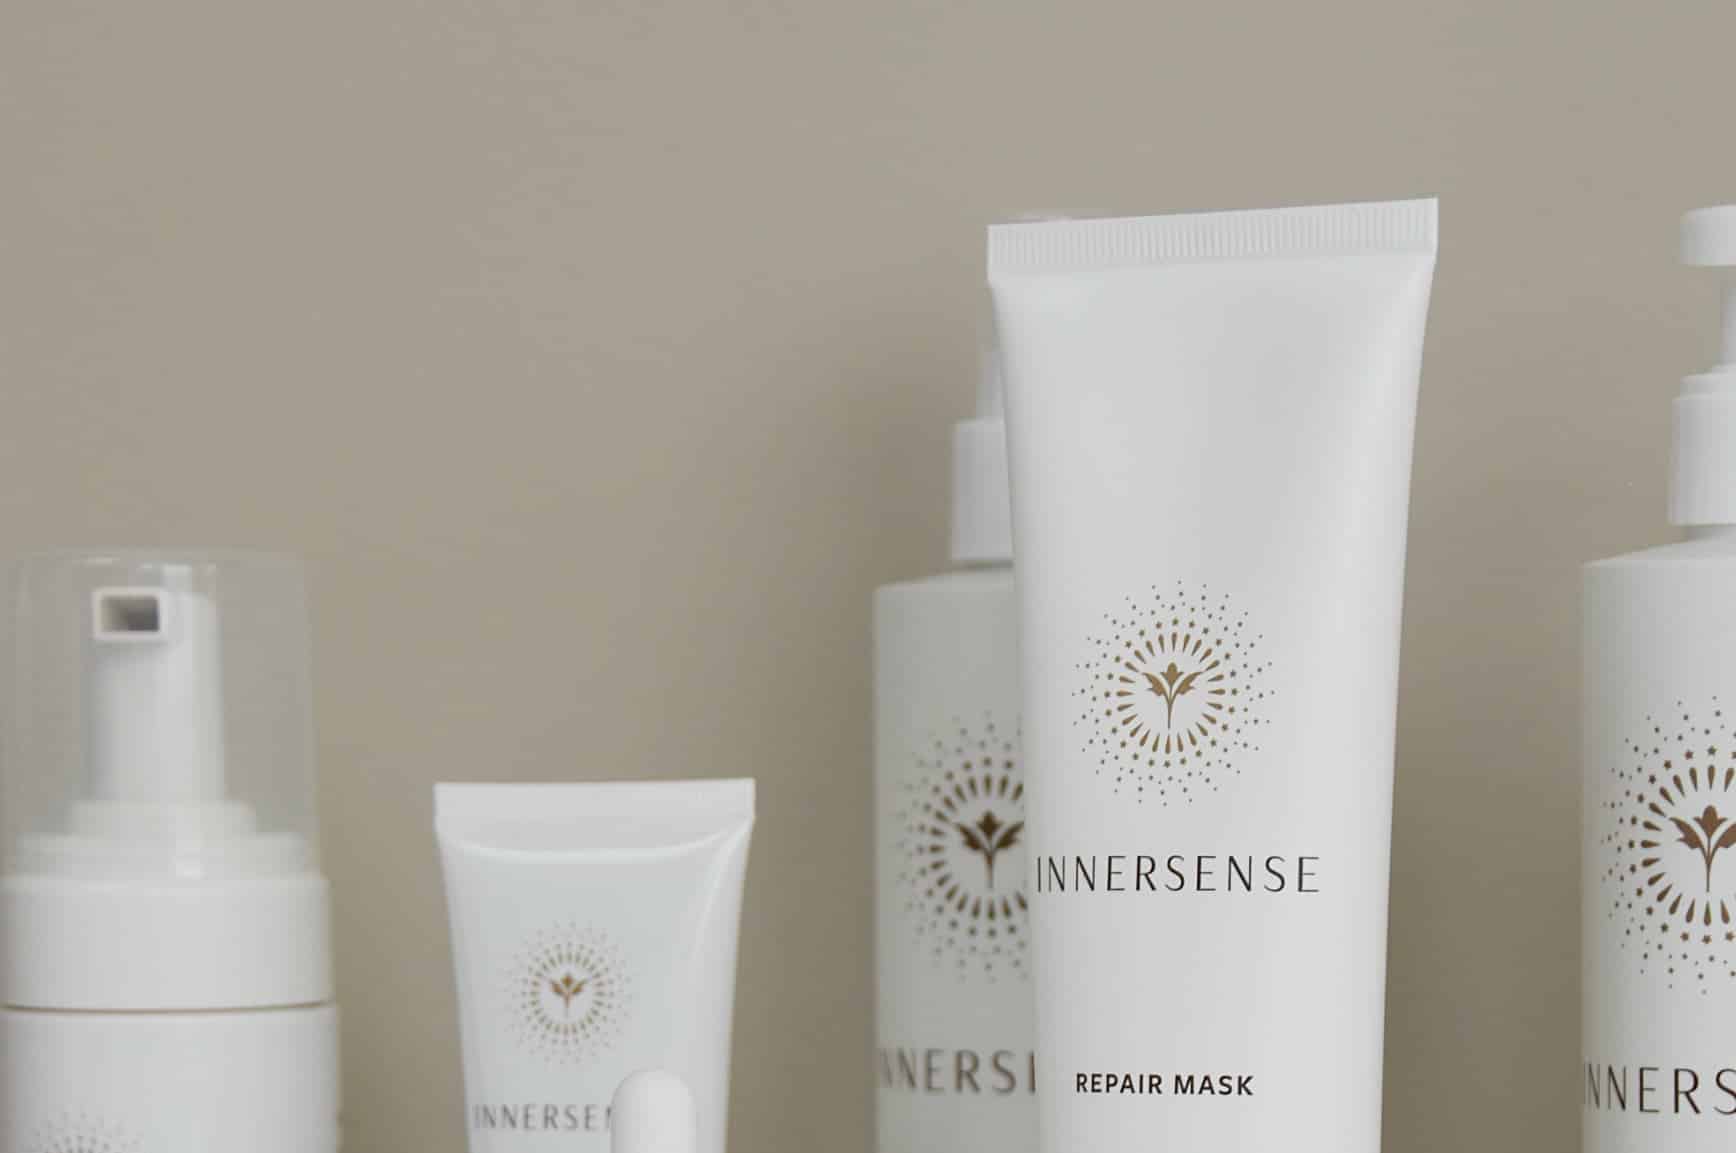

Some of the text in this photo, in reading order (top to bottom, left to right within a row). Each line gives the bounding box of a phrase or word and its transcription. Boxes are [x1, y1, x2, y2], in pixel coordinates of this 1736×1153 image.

[1036, 854, 1321, 893] INNERSENSE
[1075, 1072, 1254, 1097] REPAIR MASK
